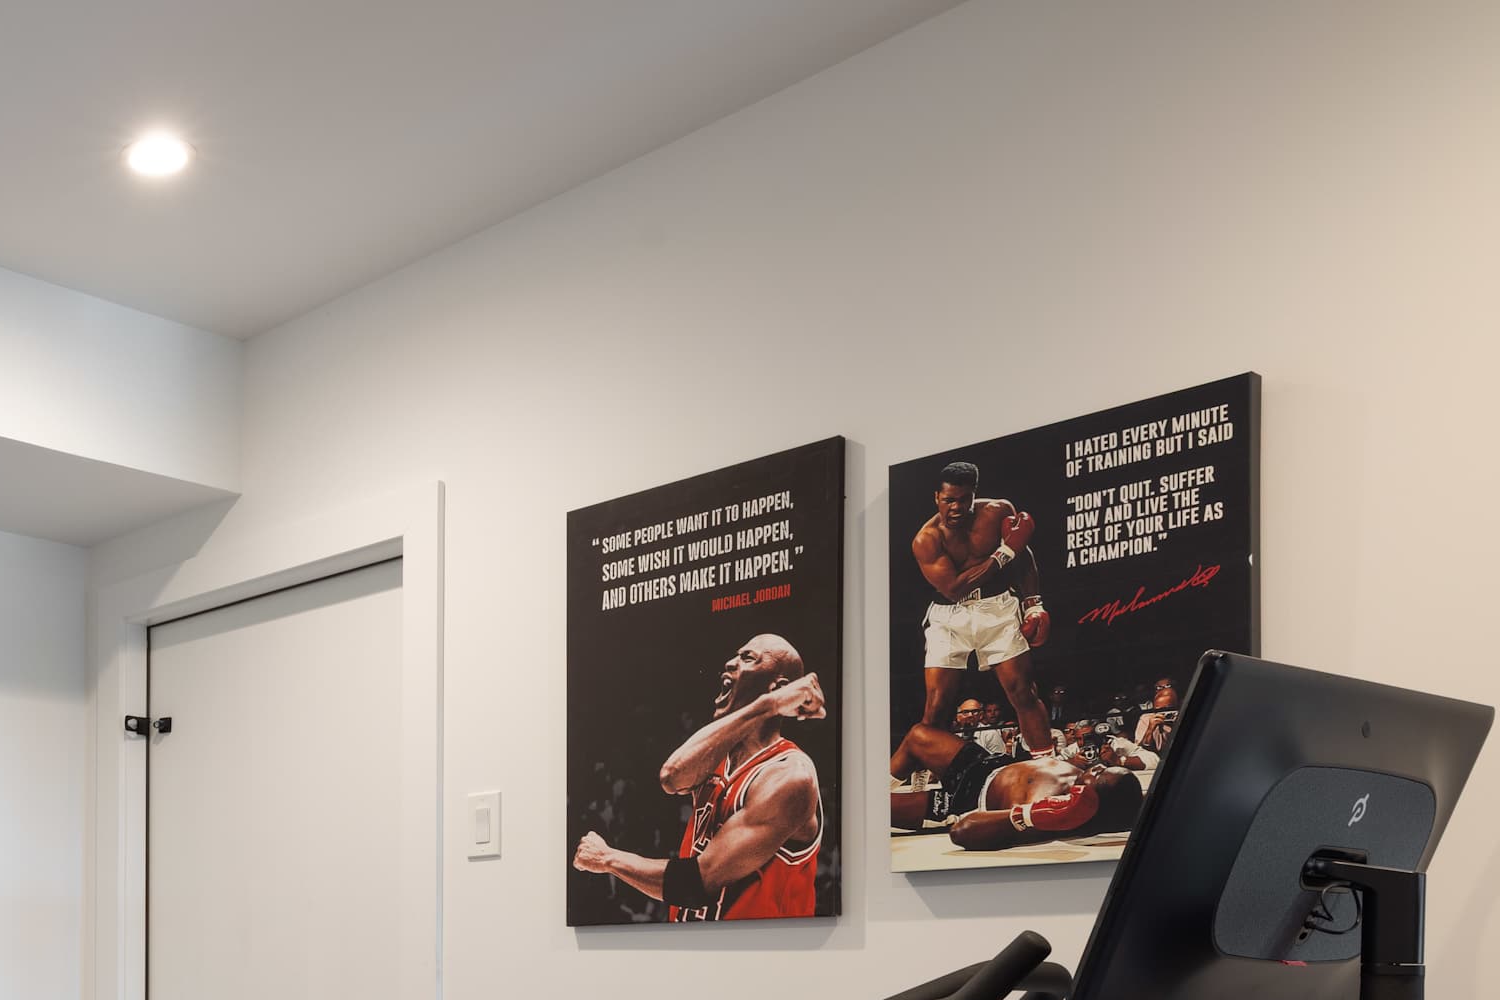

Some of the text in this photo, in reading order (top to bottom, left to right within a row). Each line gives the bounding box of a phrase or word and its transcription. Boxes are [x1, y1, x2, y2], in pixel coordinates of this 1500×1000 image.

[1065, 404, 1229, 460] I HATED EVERY MINUTE
[1066, 422, 1234, 478] OF TRAINING BUT I SAID
[1066, 487, 1200, 533] NOW AND LIVE THE
[1119, 480, 1155, 505] QUIT.
[1159, 465, 1215, 493] SUFFER
[634, 521, 673, 546] PEOPLE
[676, 511, 709, 533] WANT
[711, 508, 722, 526] IT
[725, 503, 739, 523] TO
[742, 490, 794, 518] HAPPEN,
[1066, 501, 1224, 551] REST OF YOUR LIFE AS
[602, 520, 794, 582] SOME WISH IT WOULD HAPPEN,
[1066, 556, 1076, 568] A
[602, 582, 626, 611] AND
[629, 574, 677, 605] OTHERS
[680, 564, 716, 593] MAKE
[719, 561, 731, 585] IT
[711, 584, 791, 612] MICHAEL JORDAN
